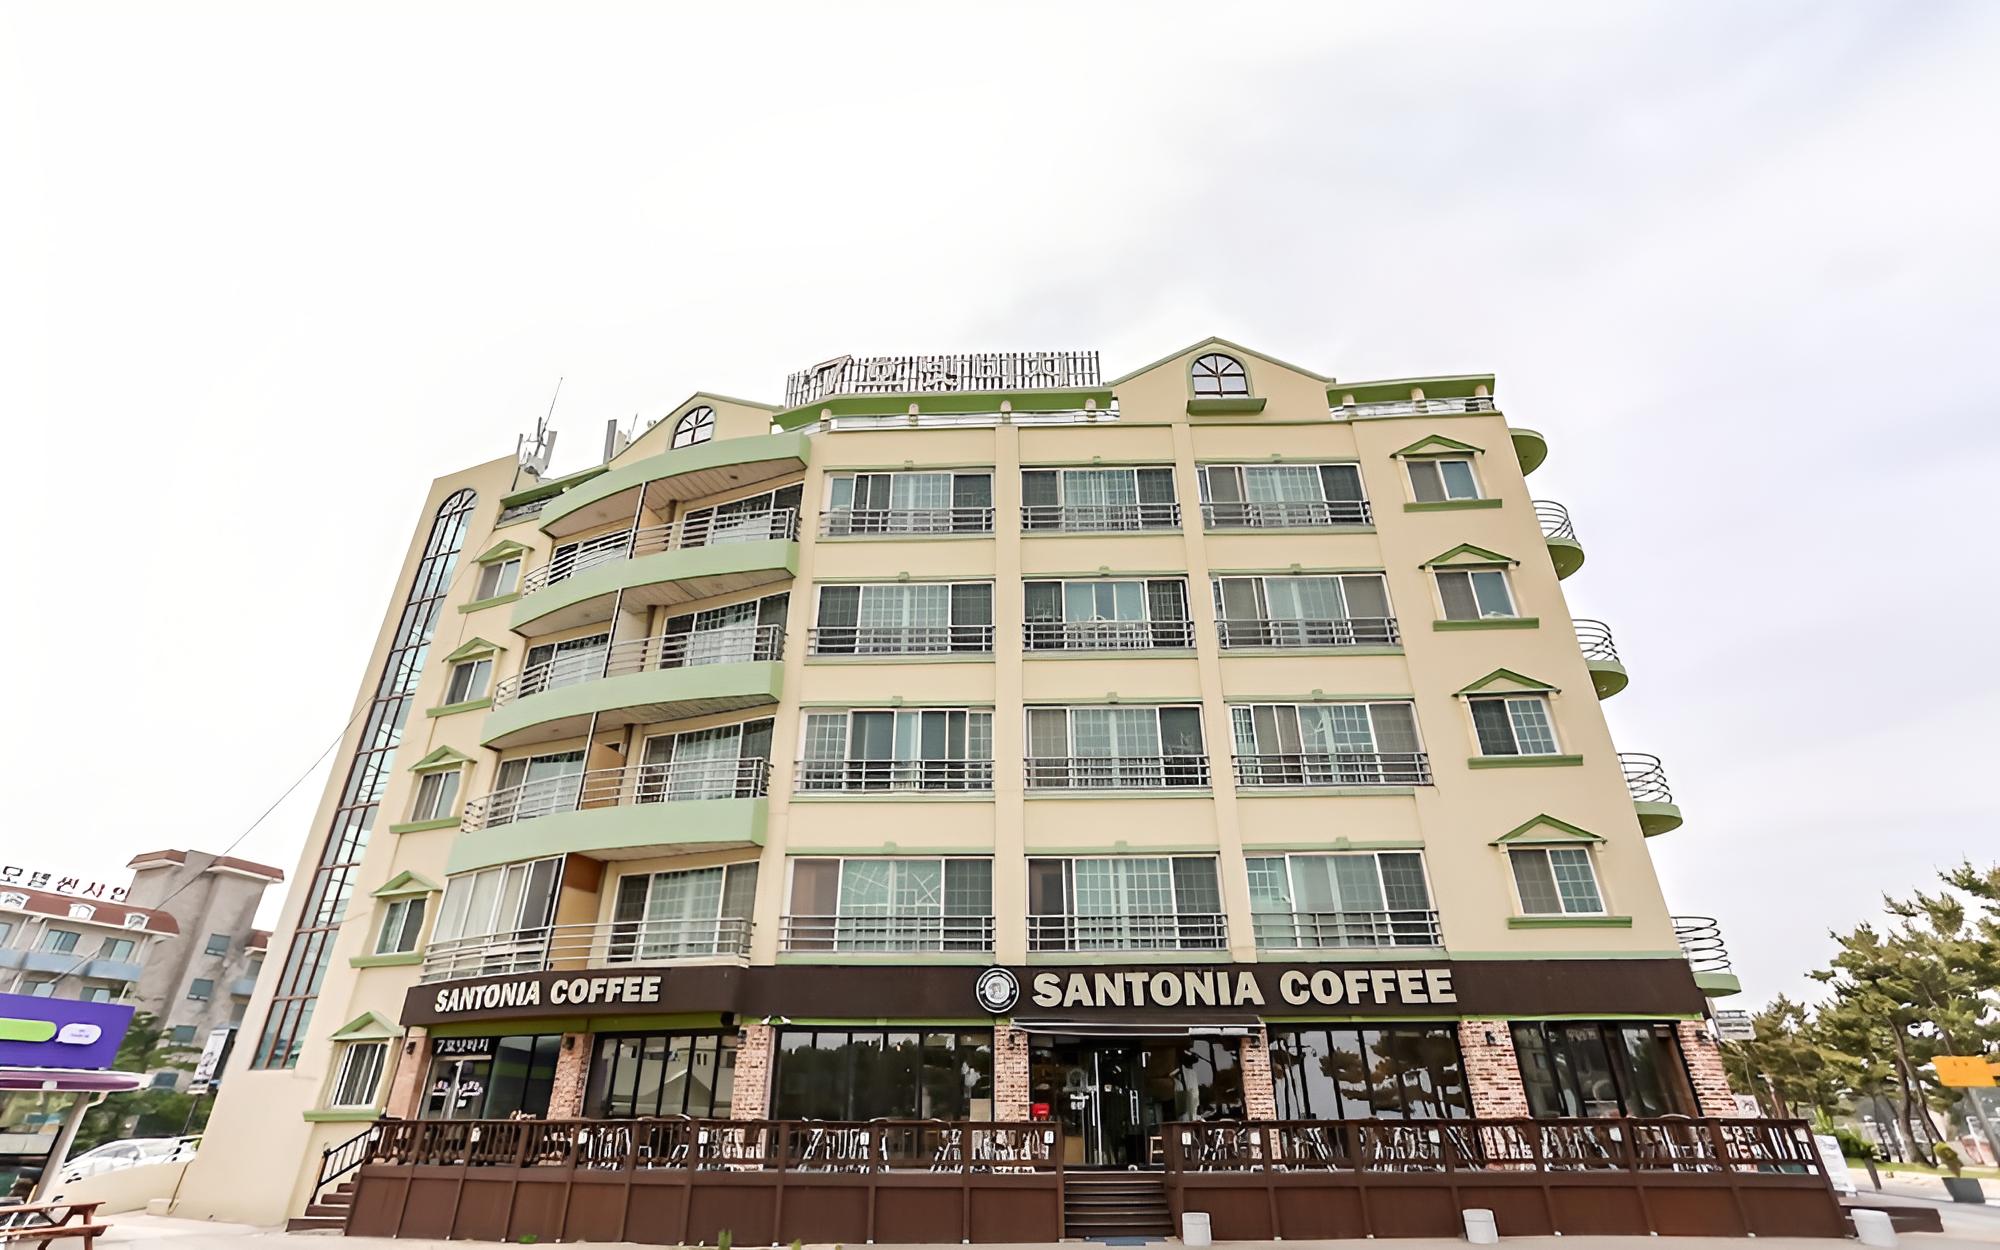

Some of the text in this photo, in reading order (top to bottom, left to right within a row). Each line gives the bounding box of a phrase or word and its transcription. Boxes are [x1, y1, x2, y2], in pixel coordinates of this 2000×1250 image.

[434, 976, 661, 1013] SANTONIA COFFEE
[1032, 972, 1265, 1007] SANTONIA
[1280, 969, 1457, 1004] COFFEE
